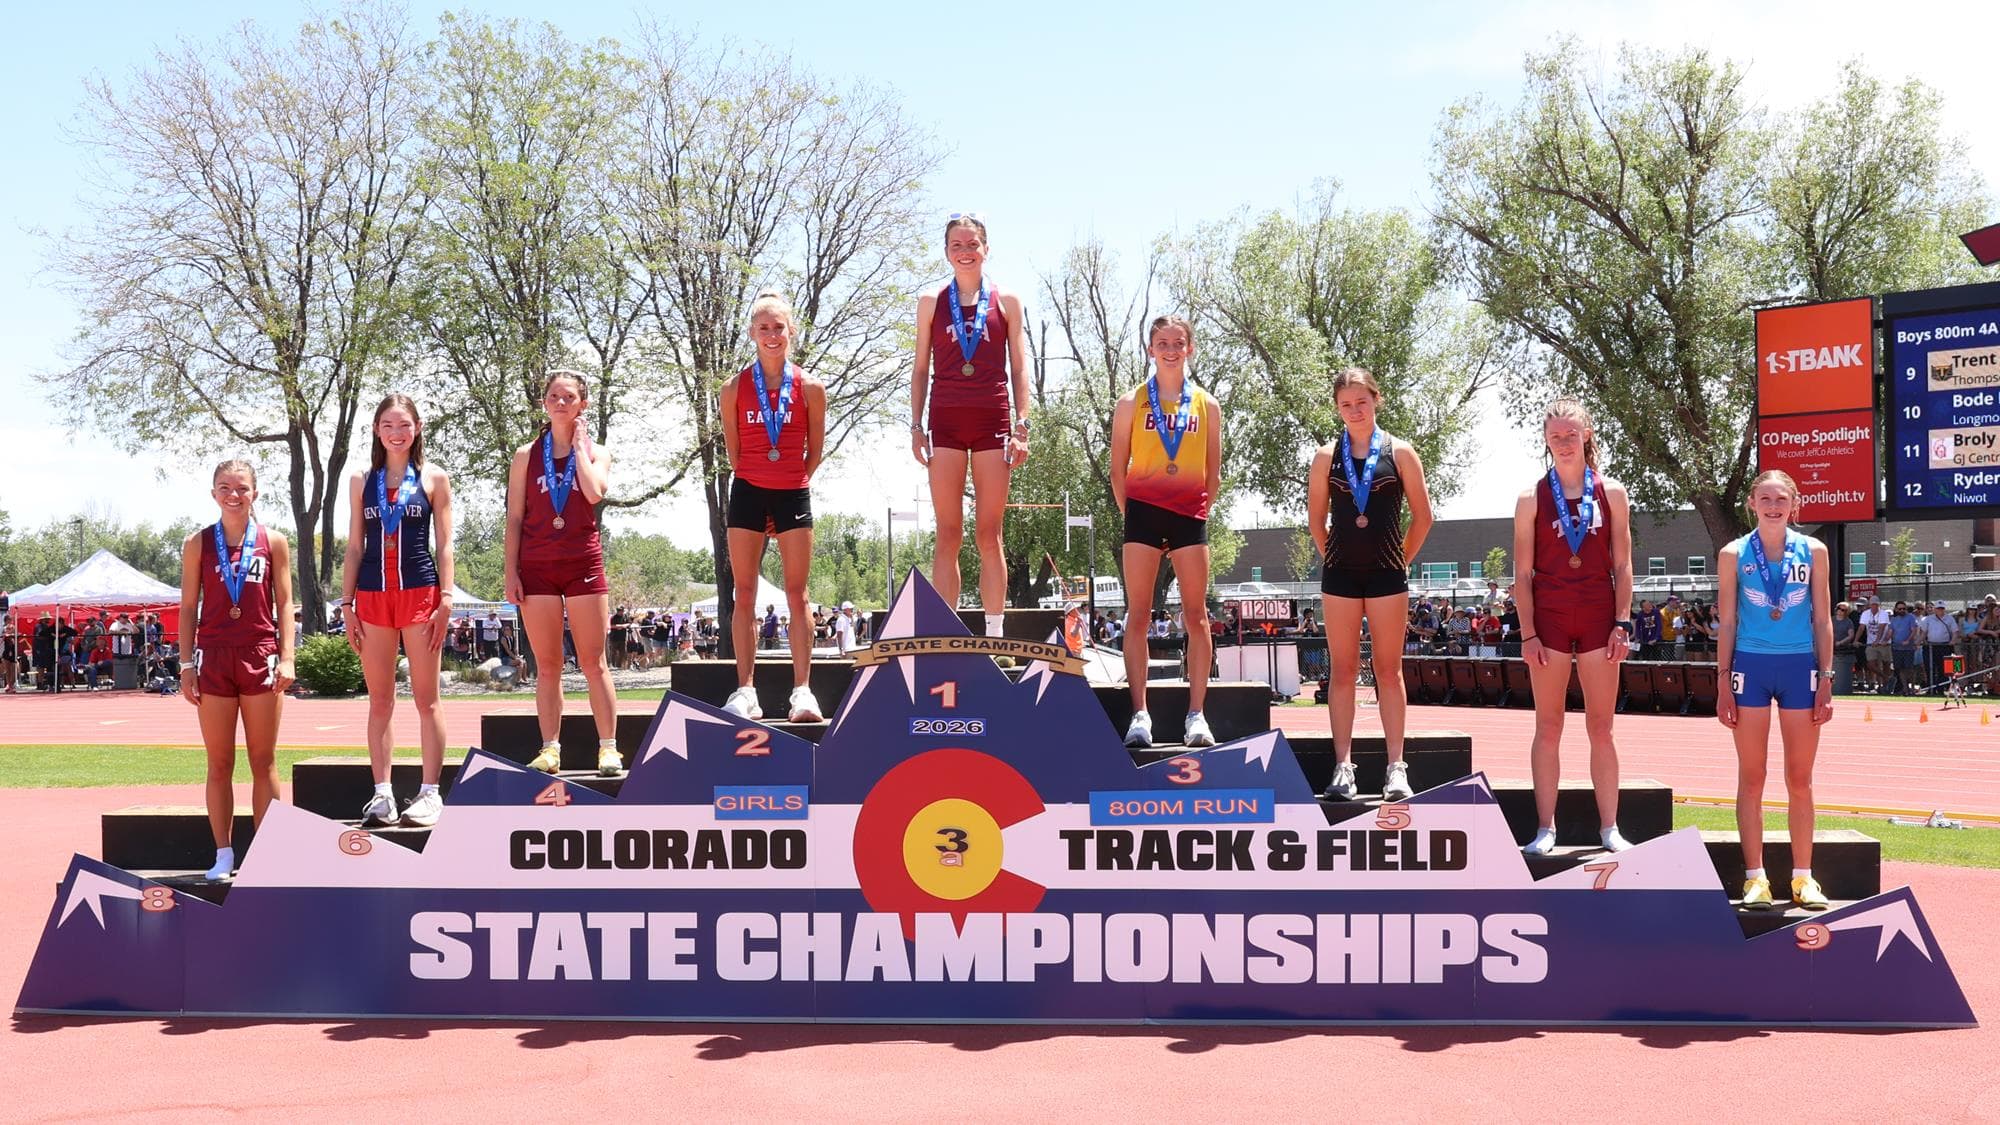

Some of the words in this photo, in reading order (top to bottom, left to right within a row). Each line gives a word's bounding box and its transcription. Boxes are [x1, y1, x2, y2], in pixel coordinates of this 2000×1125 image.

[1897, 331, 1931, 345] Boys
[1935, 326, 1974, 339] 800m
[1979, 322, 1998, 335] 4A
[1906, 367, 1916, 380] 9
[1952, 353, 1996, 367] Trent
[1953, 392, 1994, 407] Bode
[746, 410, 793, 424] EAN
[1144, 412, 1199, 433] BUH
[1903, 406, 1921, 419] 10
[1762, 433, 1780, 446] CO
[1782, 432, 1810, 447] Prep
[1812, 426, 1870, 446] Spotlight
[1904, 445, 1920, 457] 11
[1954, 432, 1996, 448] Broly
[1777, 450, 1787, 458] We
[1788, 449, 1805, 457] cover
[1827, 446, 1855, 456] Athletics
[1954, 454, 1965, 466] GJ
[1904, 483, 1922, 496] 12
[1954, 472, 2000, 489] Ryder
[1954, 493, 1987, 503] Niwot
[1791, 564, 1806, 582] 16
[878, 640, 942, 653] STATE
[949, 639, 1059, 658] CHAMPION
[930, 681, 957, 708] 1
[912, 719, 985, 734] 2026
[735, 728, 771, 756] 2
[1167, 757, 1203, 785] 3
[534, 782, 572, 807] 4
[715, 795, 803, 811] GIRLS
[1108, 801, 1184, 816] 800M
[1193, 799, 1259, 815] RUN
[1375, 803, 1411, 830] 5
[338, 830, 373, 856] 6
[509, 829, 808, 870] COLORADO
[935, 828, 969, 853] 3
[1059, 829, 1256, 871] TRACK
[1266, 829, 1307, 871] &
[1316, 829, 1468, 871] FIELD
[1584, 861, 1619, 890] 7
[141, 886, 175, 913] 8
[409, 911, 699, 981] STATE
[715, 911, 1549, 984] CHAMPIONSHIPS
[1794, 922, 1832, 950] 9
